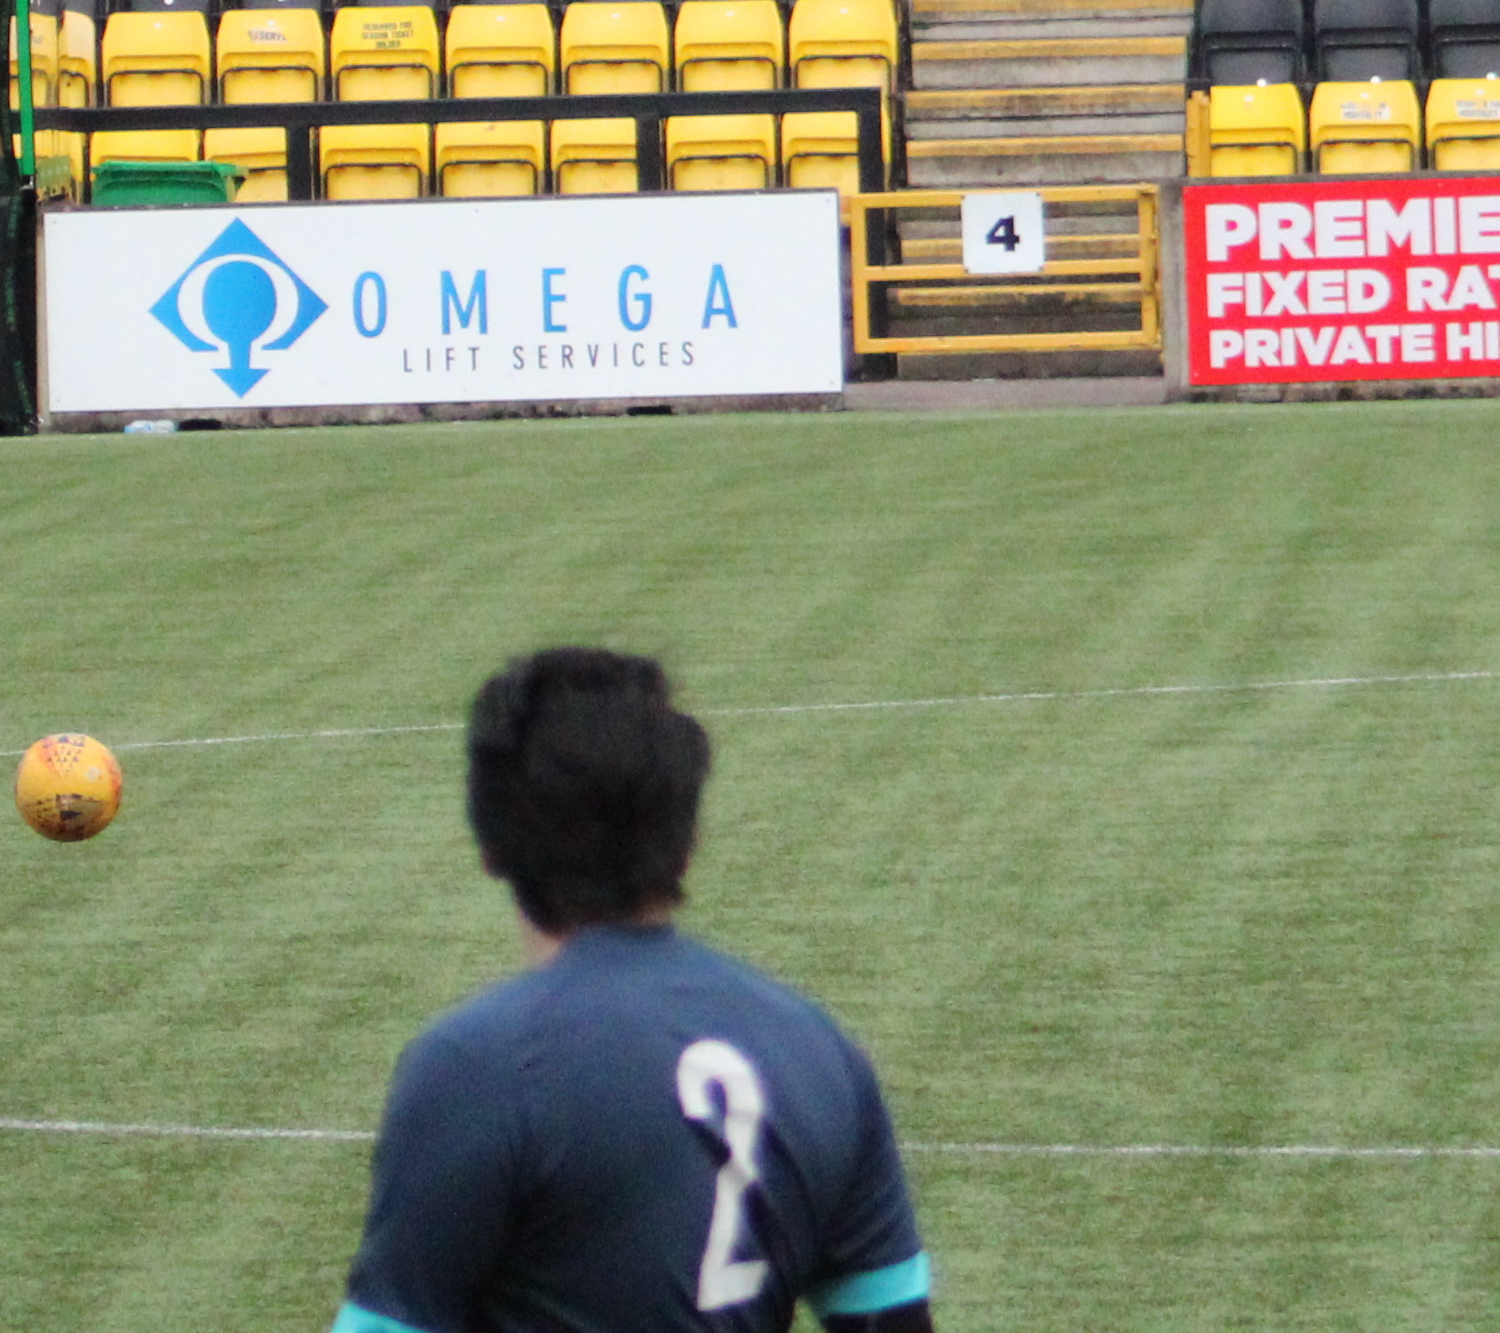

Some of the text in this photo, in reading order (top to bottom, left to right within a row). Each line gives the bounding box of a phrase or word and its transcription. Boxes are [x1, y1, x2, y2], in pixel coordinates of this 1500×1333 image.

[985, 216, 1020, 254] 4
[352, 262, 740, 339] OMEGA
[1206, 265, 1394, 318] FIXED
[402, 342, 697, 374] LIFT SERVICES
[1209, 322, 1434, 370] PRIVATE
[676, 1039, 769, 1312] 2
